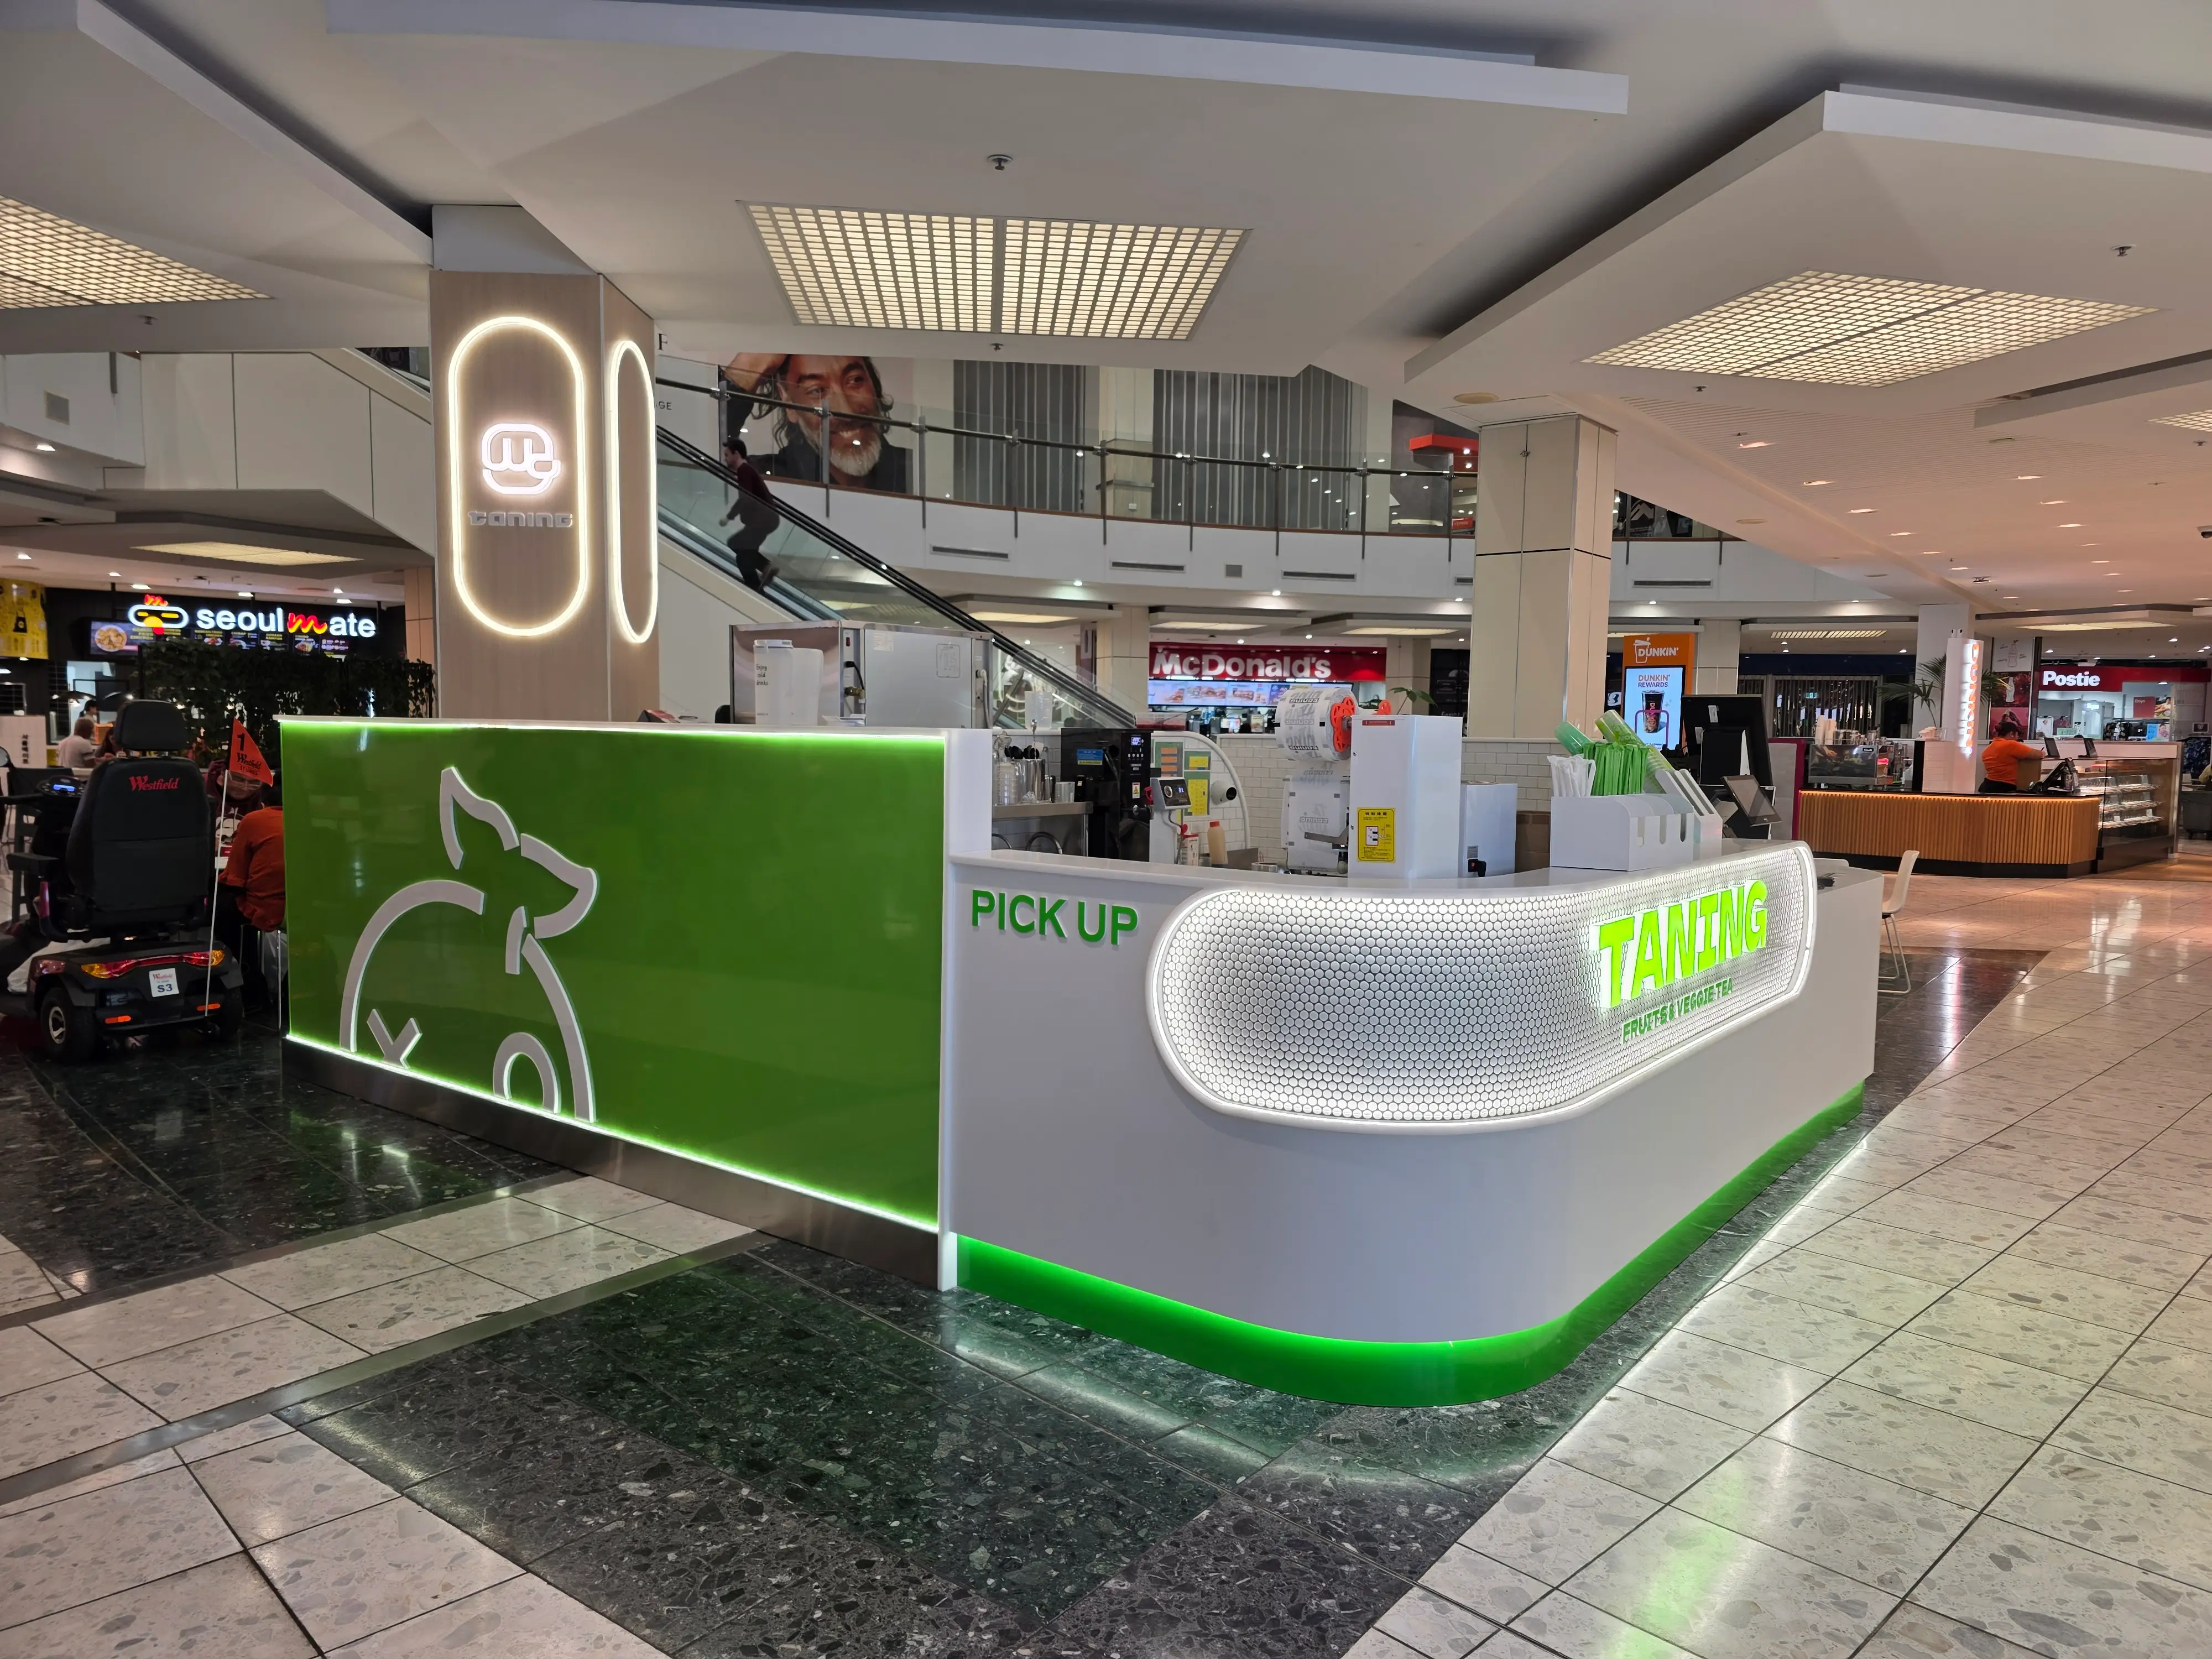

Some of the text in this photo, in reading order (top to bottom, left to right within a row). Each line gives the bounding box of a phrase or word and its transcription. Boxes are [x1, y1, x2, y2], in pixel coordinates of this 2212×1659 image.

[656, 401, 672, 410] GE
[1638, 647, 1679, 657] DUNKIN'
[1153, 652, 1331, 678] McDonald's
[2043, 670, 2100, 686] Postie
[237, 733, 245, 751] 1
[128, 775, 180, 791] Westfield
[972, 889, 1139, 945] PICK UP
[1594, 879, 1768, 1009] TANING
[157, 984, 173, 993] S3
[1623, 1005, 1668, 1044] FRUITS
[1676, 985, 1715, 1017] VEGGIE
[1716, 977, 1733, 999] TEA
